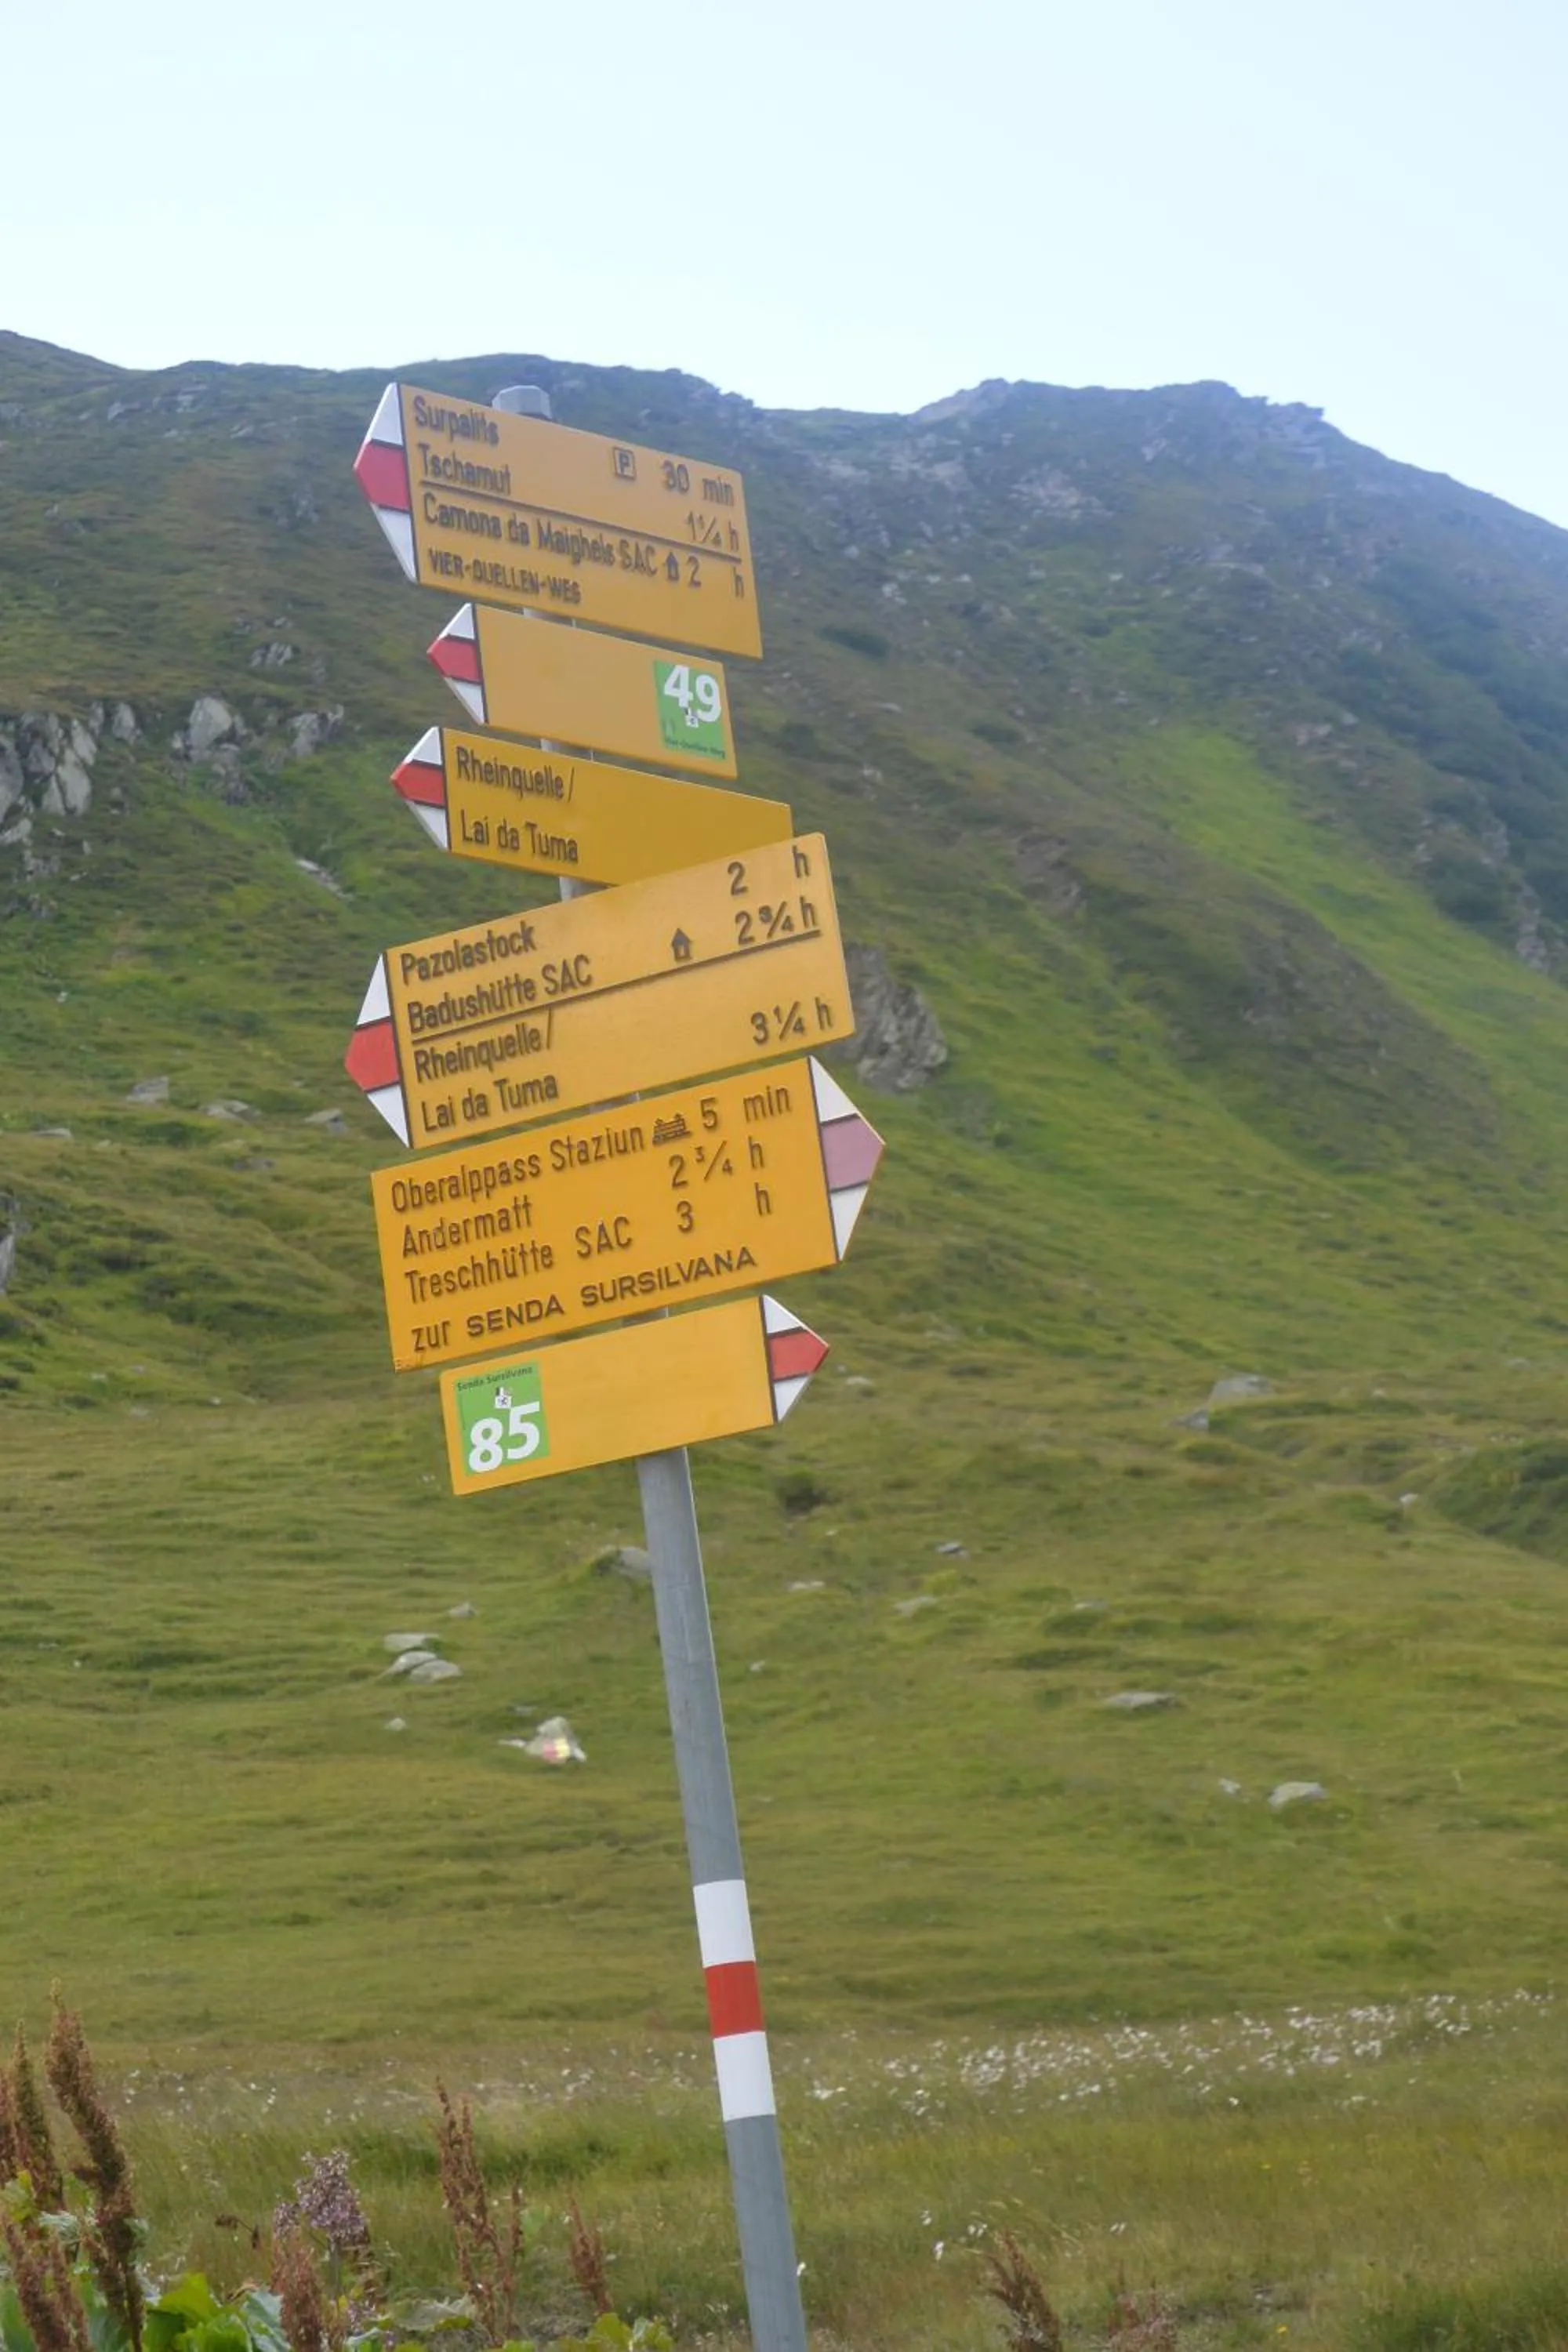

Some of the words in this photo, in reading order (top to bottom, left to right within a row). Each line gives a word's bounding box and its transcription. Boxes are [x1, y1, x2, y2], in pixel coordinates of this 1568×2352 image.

[419, 443, 511, 494] Tschamut
[729, 520, 739, 552] h
[661, 460, 690, 493] 30
[702, 477, 735, 506] min
[424, 492, 503, 539] Camona
[506, 513, 531, 546] da
[537, 518, 615, 567] Maighels
[619, 539, 658, 577] SAC
[687, 556, 702, 588] 2
[733, 566, 744, 599] h
[664, 665, 721, 723] 49
[460, 809, 490, 847] Lai
[497, 818, 520, 850] da
[525, 820, 578, 863] Tuma
[401, 920, 537, 985] Pazolastock
[728, 862, 747, 895] 2
[793, 844, 810, 878] h
[408, 973, 536, 1033] Badushütte
[542, 954, 593, 995] SAC
[799, 895, 816, 928] h
[422, 1097, 456, 1131] Lai
[462, 1088, 490, 1121] da
[494, 1075, 559, 1112] Tuma
[815, 996, 832, 1030] h
[391, 1153, 541, 1212] Oberalppass
[550, 1127, 644, 1171] Staziun
[700, 1098, 717, 1130] 5
[743, 1086, 791, 1123] min
[402, 1195, 532, 1258] Andermatt
[749, 1136, 764, 1169] h
[405, 1240, 554, 1304] Treschhütte
[575, 1216, 633, 1258] SAC
[677, 1201, 693, 1233] 3
[754, 1182, 771, 1216] h
[412, 1321, 450, 1352] zur
[466, 1294, 564, 1338] SENDA
[579, 1247, 757, 1307] SURSILVANA
[469, 1401, 540, 1472] 85
